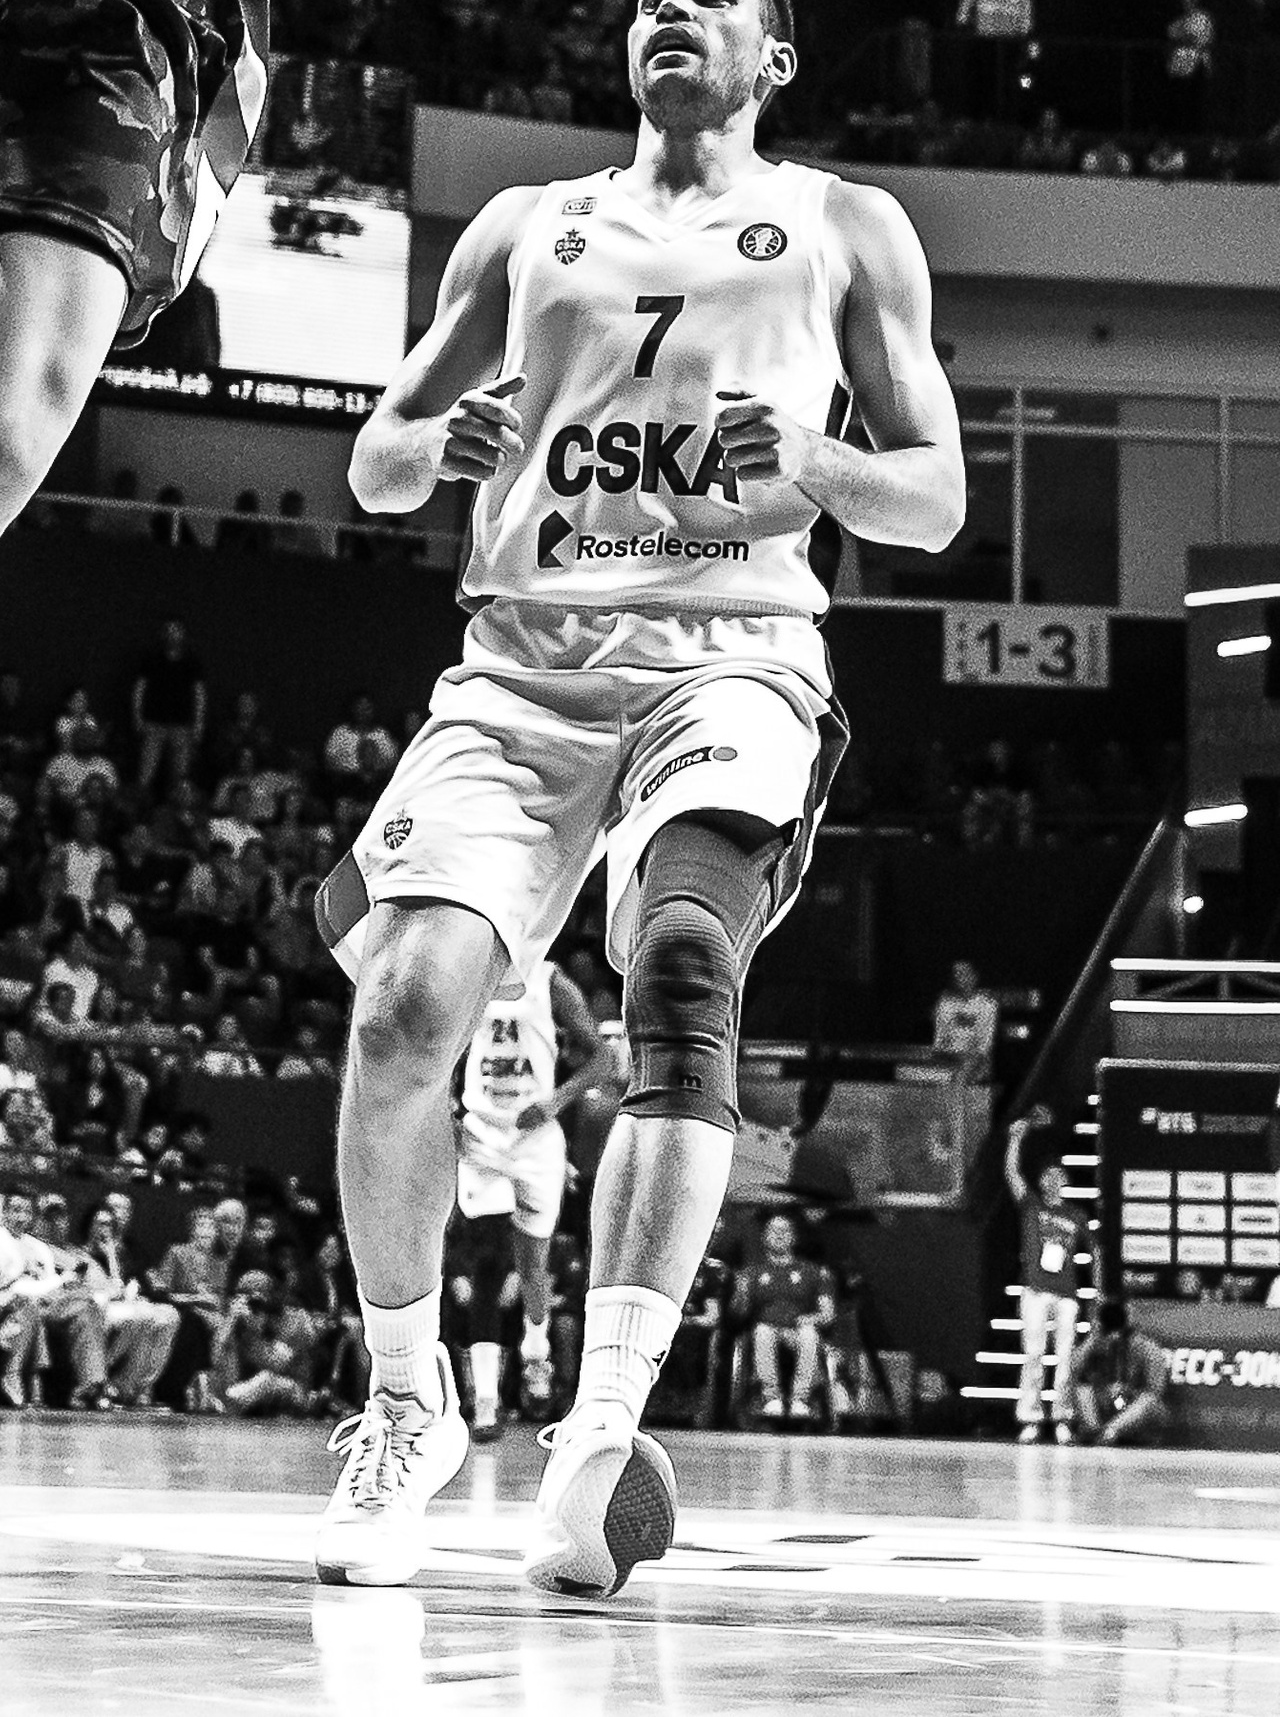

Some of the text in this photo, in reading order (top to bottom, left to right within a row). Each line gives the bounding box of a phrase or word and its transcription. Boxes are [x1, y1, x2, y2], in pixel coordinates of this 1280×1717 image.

[633, 295, 685, 378] 7
[546, 421, 741, 505] CSKA
[576, 531, 749, 562] Rostelecom
[977, 621, 1077, 678] 1-3
